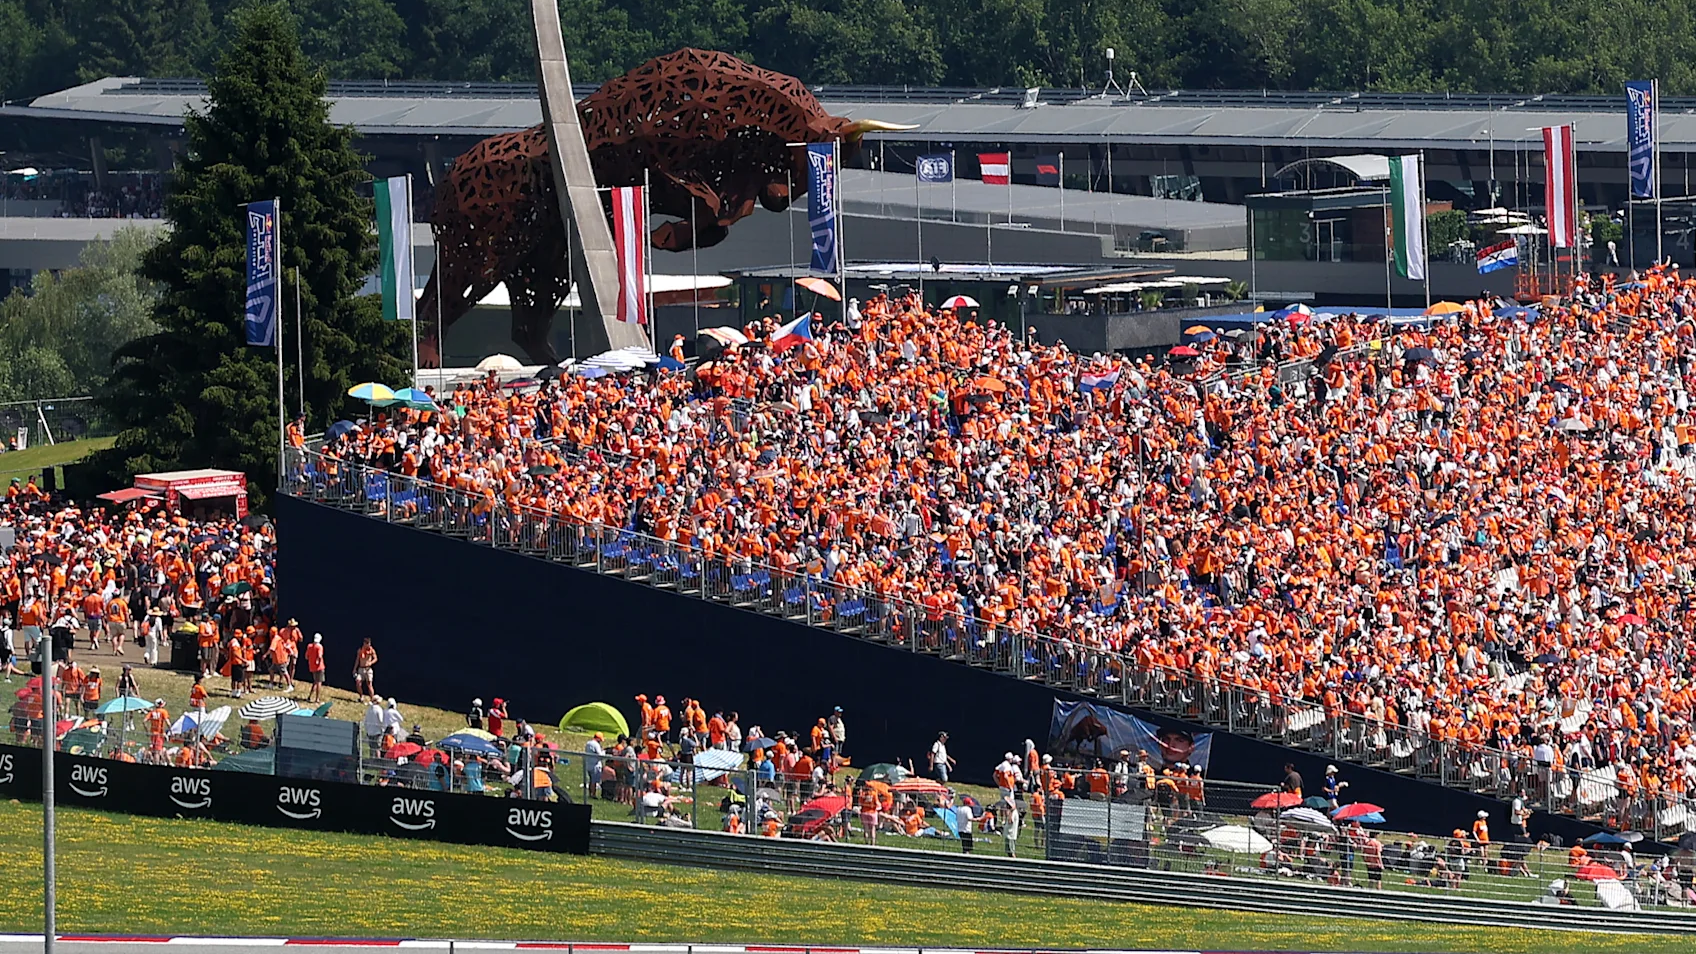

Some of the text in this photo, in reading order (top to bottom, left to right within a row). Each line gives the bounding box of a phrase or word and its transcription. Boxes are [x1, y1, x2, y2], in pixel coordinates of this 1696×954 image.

[1299, 222, 1311, 243] 3
[1676, 231, 1690, 250] 4
[71, 764, 107, 785] aws
[171, 776, 210, 796] aws
[278, 786, 321, 807] aws
[391, 797, 435, 818] aws
[507, 807, 552, 828] aws
